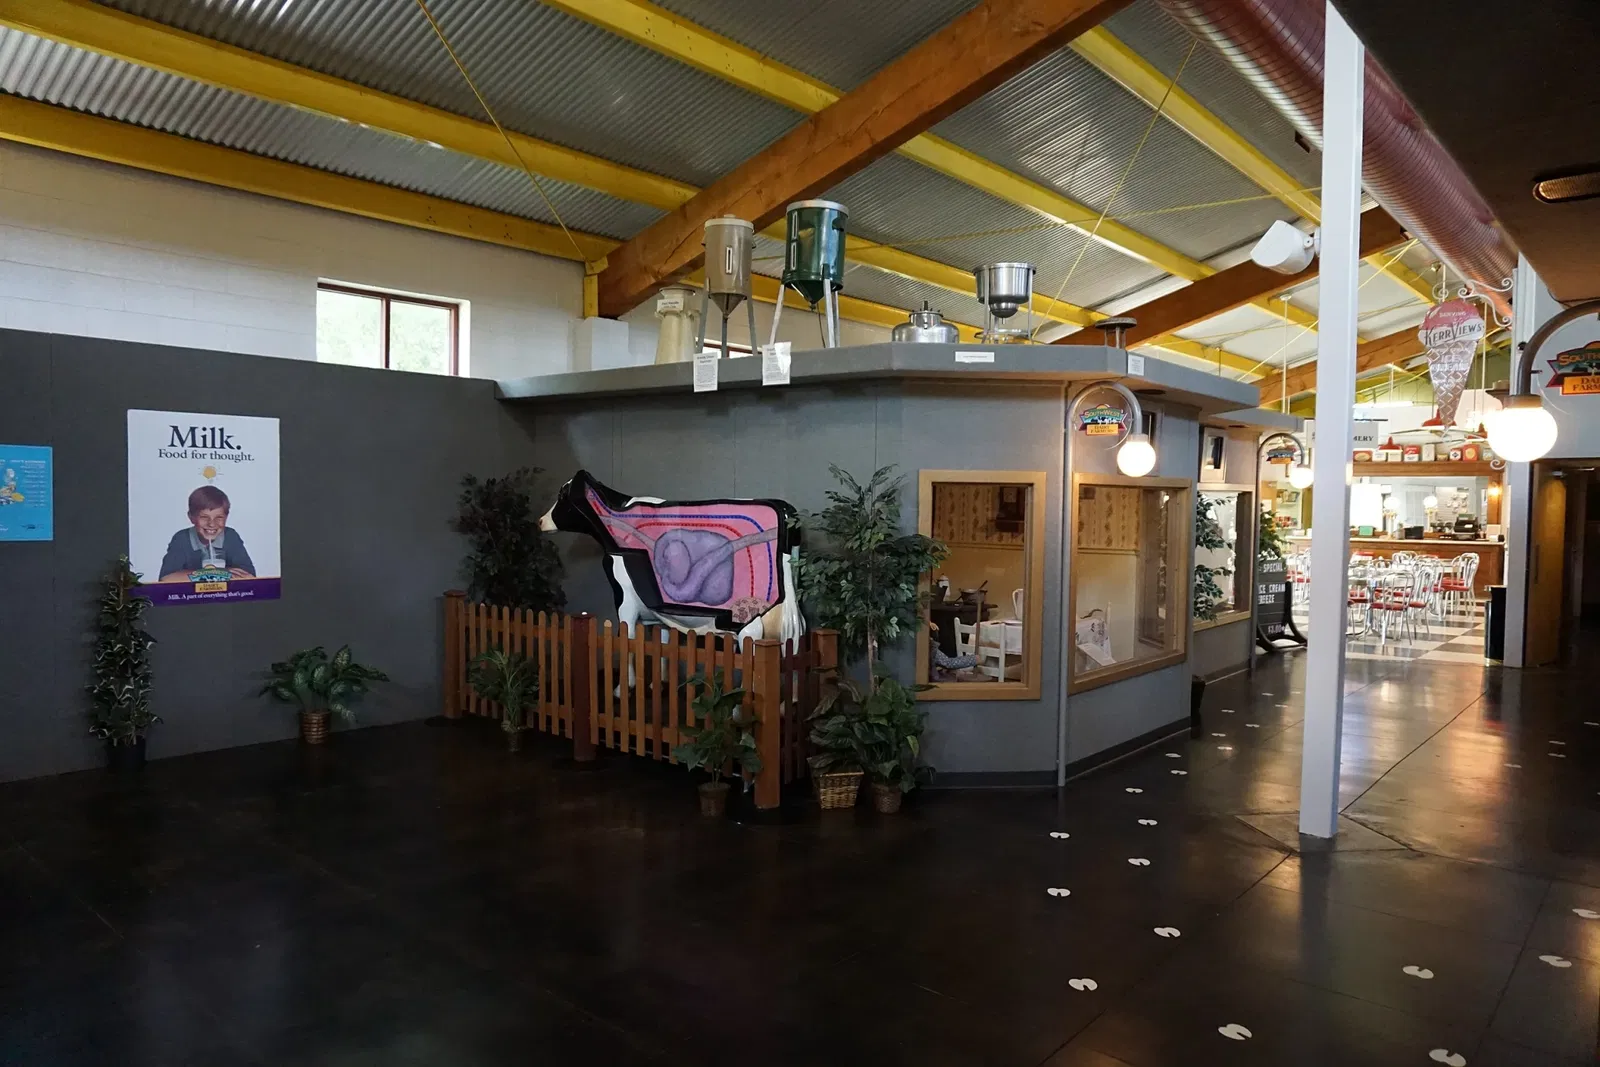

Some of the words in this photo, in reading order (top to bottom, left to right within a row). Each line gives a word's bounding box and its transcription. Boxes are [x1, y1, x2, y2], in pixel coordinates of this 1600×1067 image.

[168, 424, 242, 451] Milk.
[158, 448, 188, 459] Food
[191, 449, 207, 460] for
[209, 450, 255, 464] thought.
